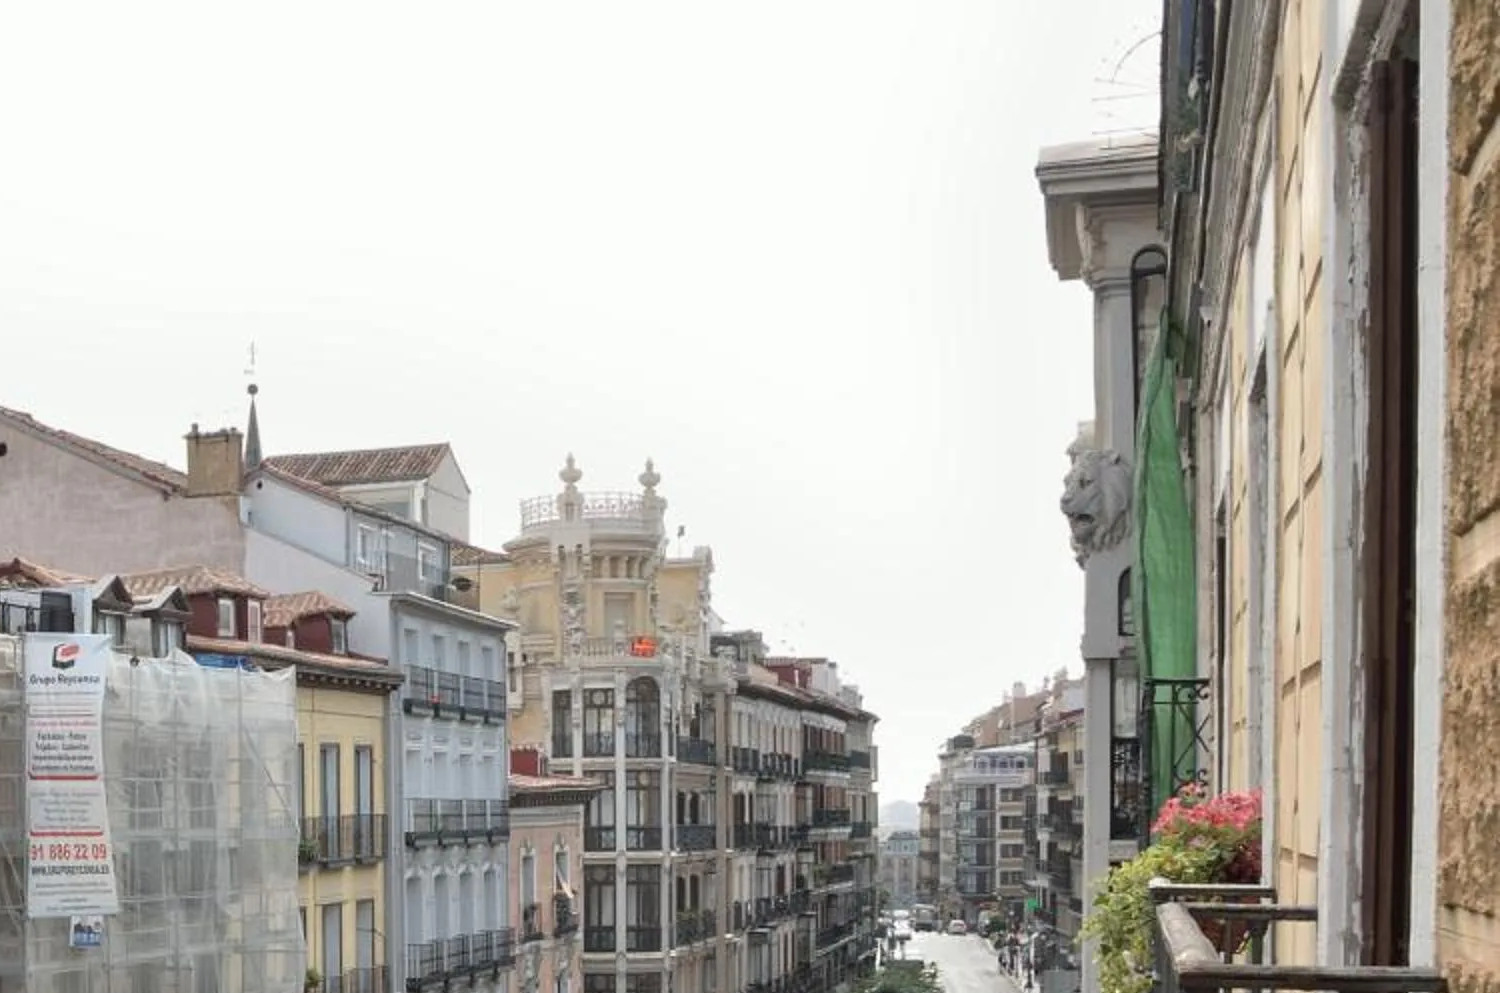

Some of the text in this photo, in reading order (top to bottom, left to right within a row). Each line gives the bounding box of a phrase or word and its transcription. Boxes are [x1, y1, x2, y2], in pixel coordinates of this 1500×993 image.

[31, 844, 44, 861] 91
[74, 843, 89, 860] 22
[91, 843, 107, 860] 09
